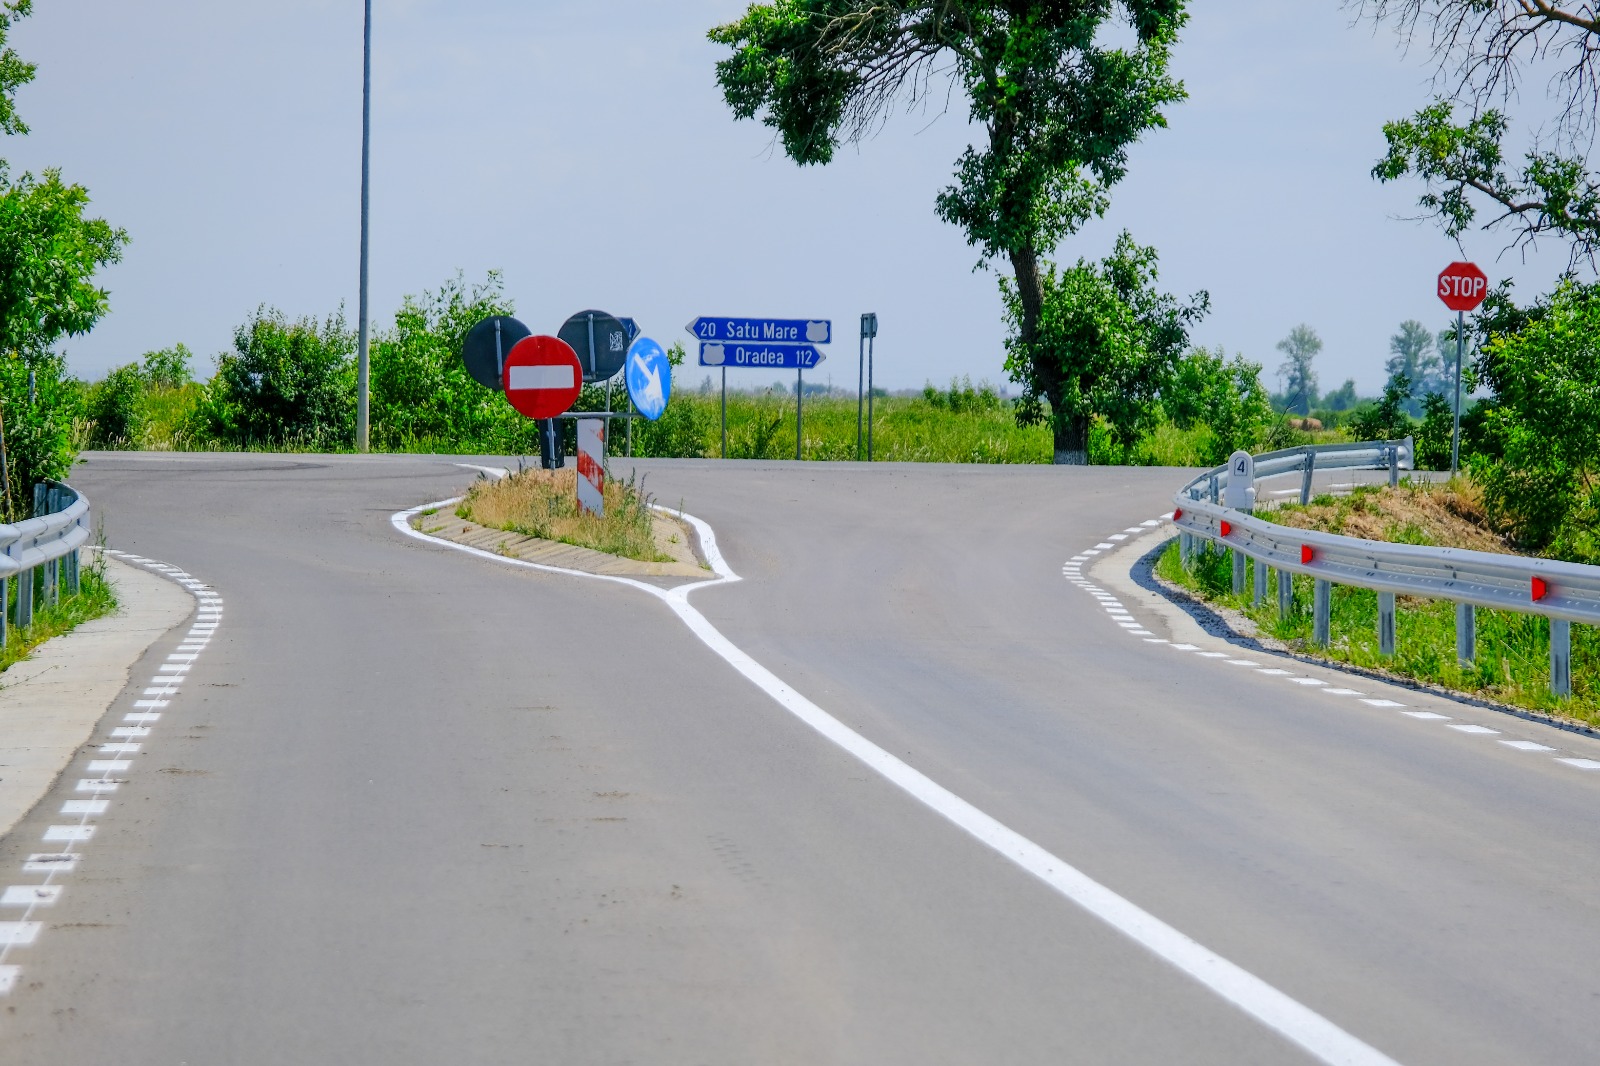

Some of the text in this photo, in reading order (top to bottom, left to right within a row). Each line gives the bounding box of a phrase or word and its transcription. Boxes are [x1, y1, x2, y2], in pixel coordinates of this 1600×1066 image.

[1440, 275, 1485, 297] STOP
[700, 321, 798, 340] 20 Satu Mare
[736, 346, 813, 365] Oradea 112
[1237, 460, 1245, 473] 4
